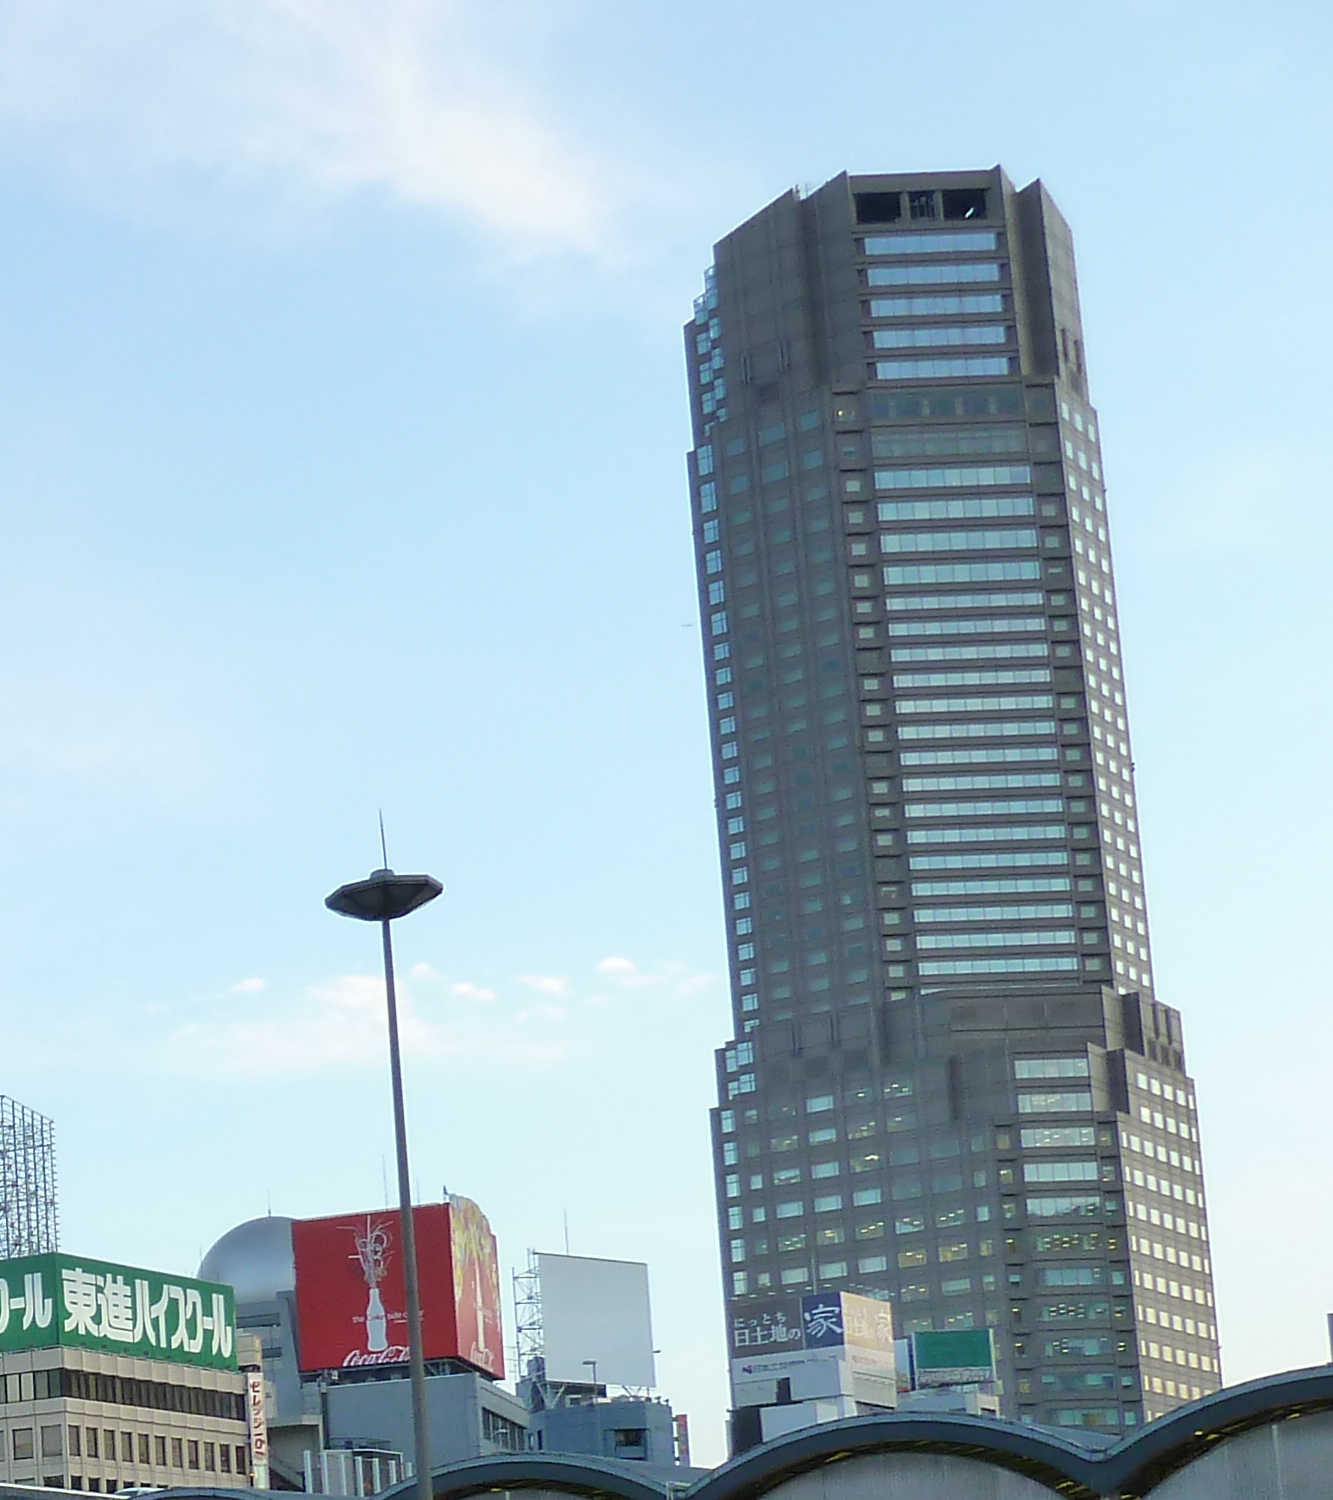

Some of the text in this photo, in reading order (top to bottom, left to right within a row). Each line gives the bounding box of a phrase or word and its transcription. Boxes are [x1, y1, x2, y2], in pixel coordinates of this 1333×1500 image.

[61, 1267, 232, 1359] 東進ハイスクール
[734, 1311, 786, 1328] にっとち
[804, 1303, 843, 1338] 家
[735, 1325, 801, 1346] 日土地の
